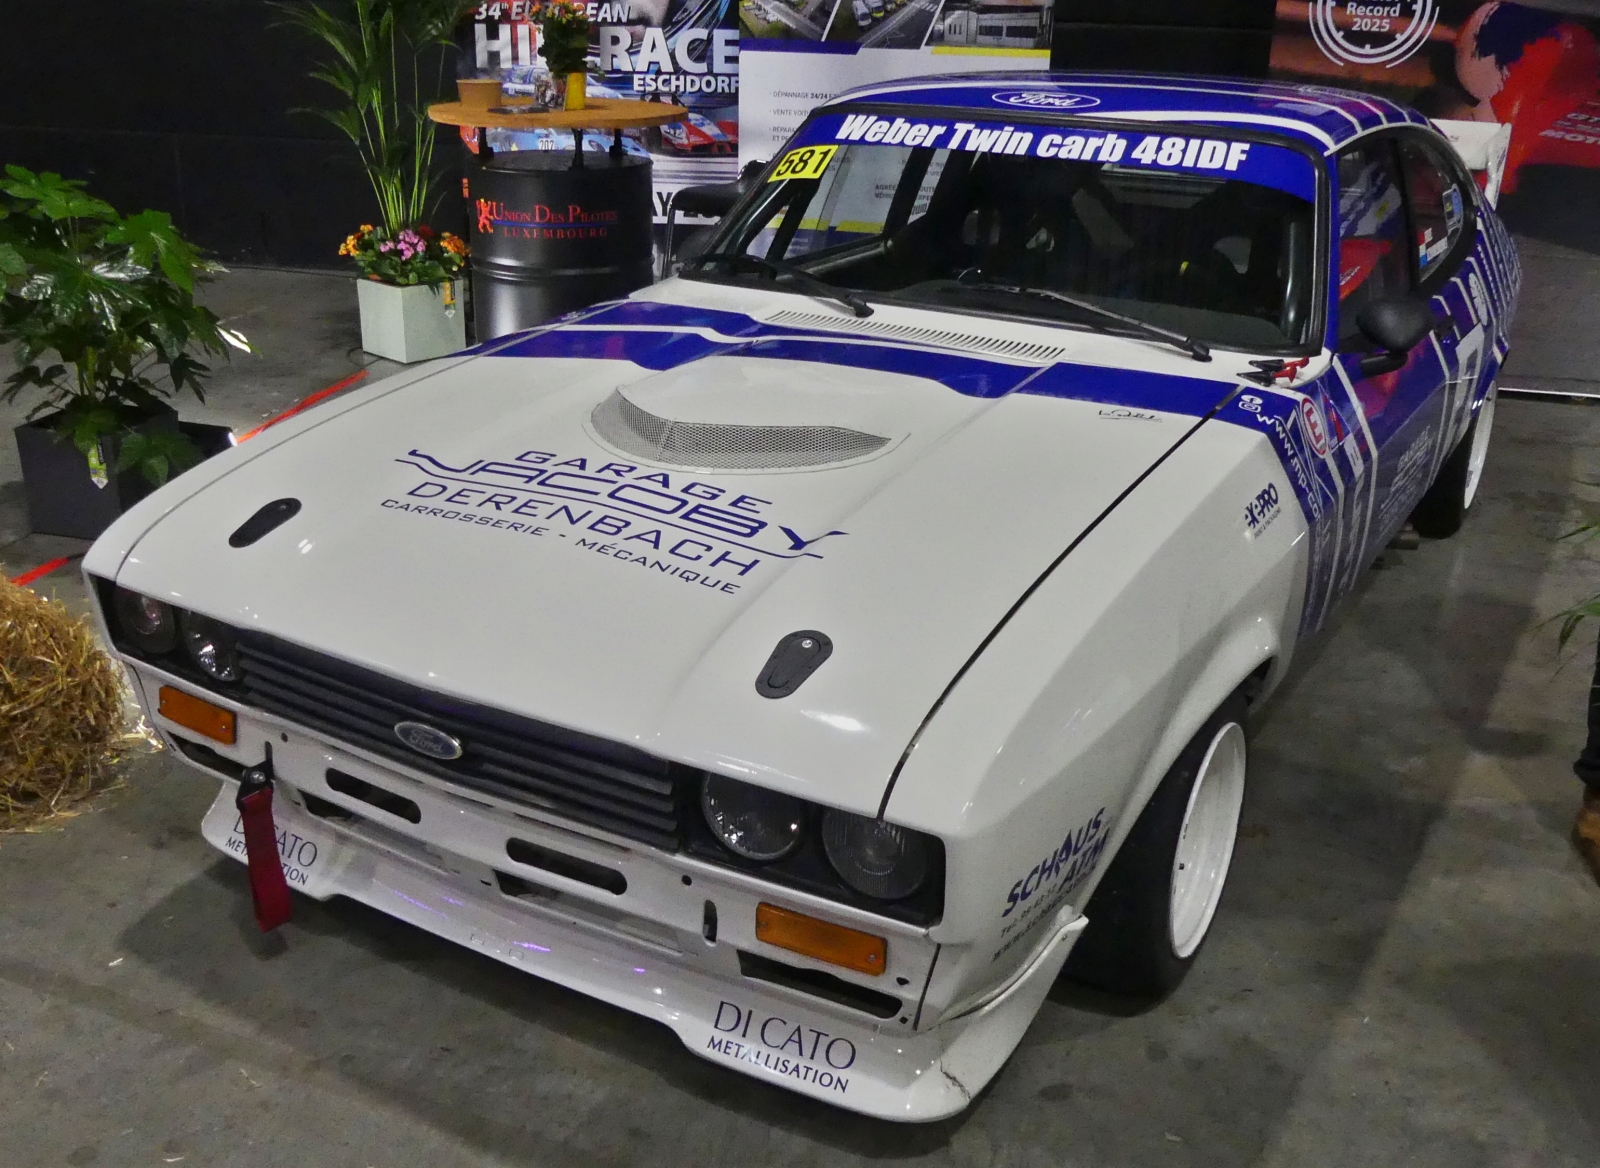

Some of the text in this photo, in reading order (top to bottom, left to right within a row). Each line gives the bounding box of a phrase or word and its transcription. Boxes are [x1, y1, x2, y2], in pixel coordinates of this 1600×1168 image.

[1346, 2, 1401, 17] Record
[1351, 19, 1390, 32] 2025
[600, 26, 739, 74] RACE
[773, 91, 809, 99] DÉPANNAGE
[1009, 93, 1081, 107] Ford
[776, 148, 832, 177] 581
[835, 114, 1250, 172] Weber Twin carb 48IDF
[503, 227, 608, 239] LUXEMBOURG
[406, 449, 849, 551] JACOBY
[515, 450, 772, 513] GARAGE
[381, 499, 550, 537] CARROSSERIE
[575, 541, 741, 594] MÉCANIQUE
[407, 481, 761, 576] DERENBACH
[1001, 806, 1106, 918] SCHAUS
[713, 1000, 857, 1070] DI CATO
[707, 1035, 849, 1094] METALLISATION
